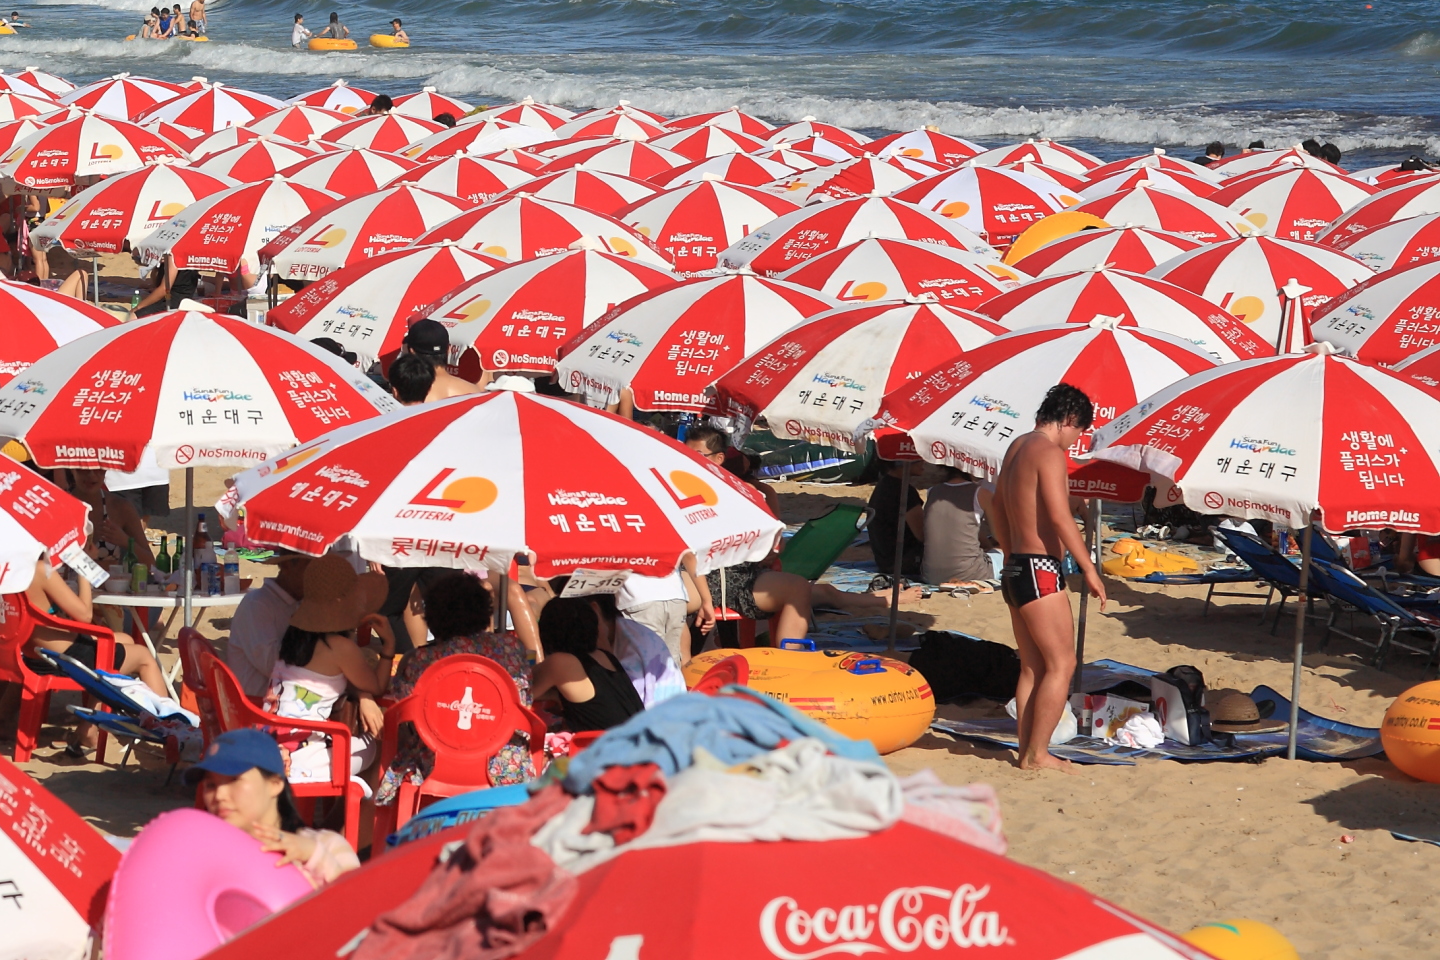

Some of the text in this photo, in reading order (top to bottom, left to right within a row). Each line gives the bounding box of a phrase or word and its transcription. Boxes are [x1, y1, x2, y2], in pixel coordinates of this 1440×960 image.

[29, 157, 69, 169] 해운대구
[187, 255, 228, 269] Home plus
[323, 319, 374, 339] 해운대구
[501, 324, 567, 339] 해운대구
[678, 329, 725, 345] 생활에
[1398, 334, 1434, 350] 됩니다
[666, 344, 720, 361] 플러스가
[91, 369, 143, 388] 생활에
[675, 361, 715, 377] 됩니다
[277, 371, 323, 388] 생활에
[71, 387, 132, 407] 플러스가
[183, 390, 253, 402] Haeundae
[286, 387, 338, 407] 플러스가
[654, 390, 717, 407] Home plus
[797, 389, 864, 415] 해운대구
[78, 406, 123, 425] 됩니다
[179, 407, 264, 426] 해운대구
[309, 405, 352, 425] 됩니다
[951, 410, 1014, 443] 해운대구
[1229, 438, 1297, 458] Haeundae
[1340, 429, 1395, 450] 생활에
[54, 444, 126, 467] Home plus
[198, 446, 268, 463] NoSmoking
[1338, 450, 1401, 471] 플러스가
[1216, 456, 1298, 482] 해운대구
[1358, 470, 1405, 490] 됩니다
[288, 481, 359, 512] 해운대구
[547, 493, 628, 507] Haeundae
[394, 508, 455, 522] LOTTERIA
[684, 506, 720, 526] LOTTERIA
[1227, 494, 1292, 520] NoSmoking
[548, 513, 647, 534] 해운대구
[1345, 509, 1420, 528] Home plus
[391, 536, 489, 561] 롯데리아
[703, 529, 761, 563] 롯데리아
[551, 556, 658, 569] www.sunnfun.co.kr
[760, 883, 1010, 958] Coca-Cola
